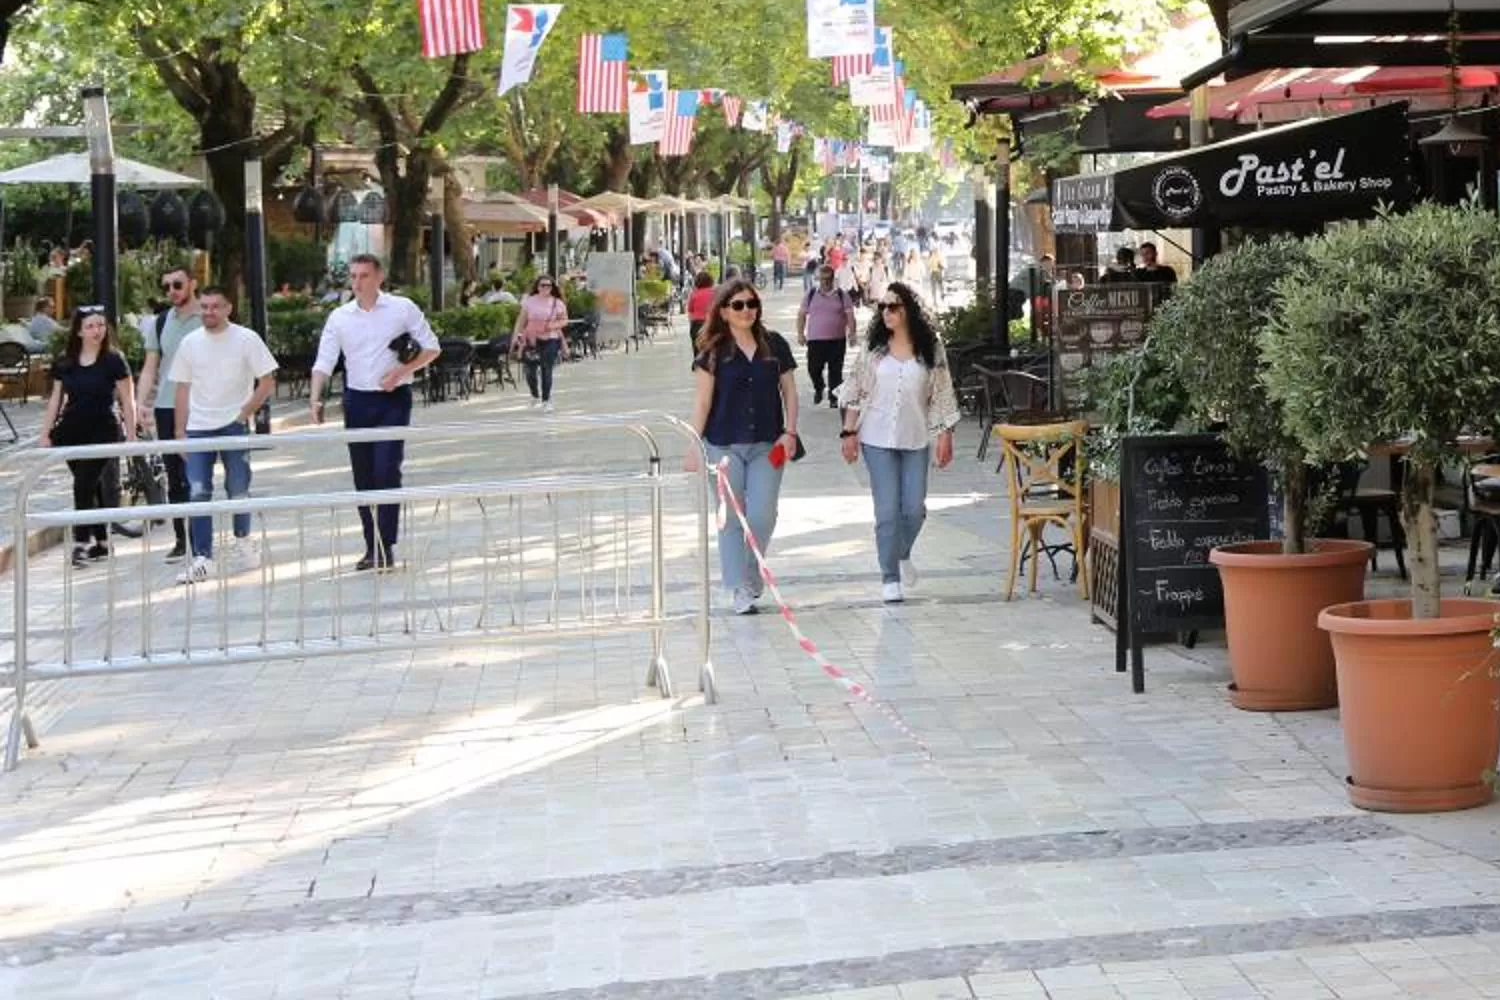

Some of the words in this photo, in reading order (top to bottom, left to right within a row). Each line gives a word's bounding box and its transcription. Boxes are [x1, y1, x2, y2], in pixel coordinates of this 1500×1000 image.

[1219, 147, 1346, 197] Past'el
[1256, 182, 1297, 197] Pastry
[1301, 181, 1311, 193] &
[1313, 178, 1357, 193] Bakery
[1359, 175, 1393, 190] Shop
